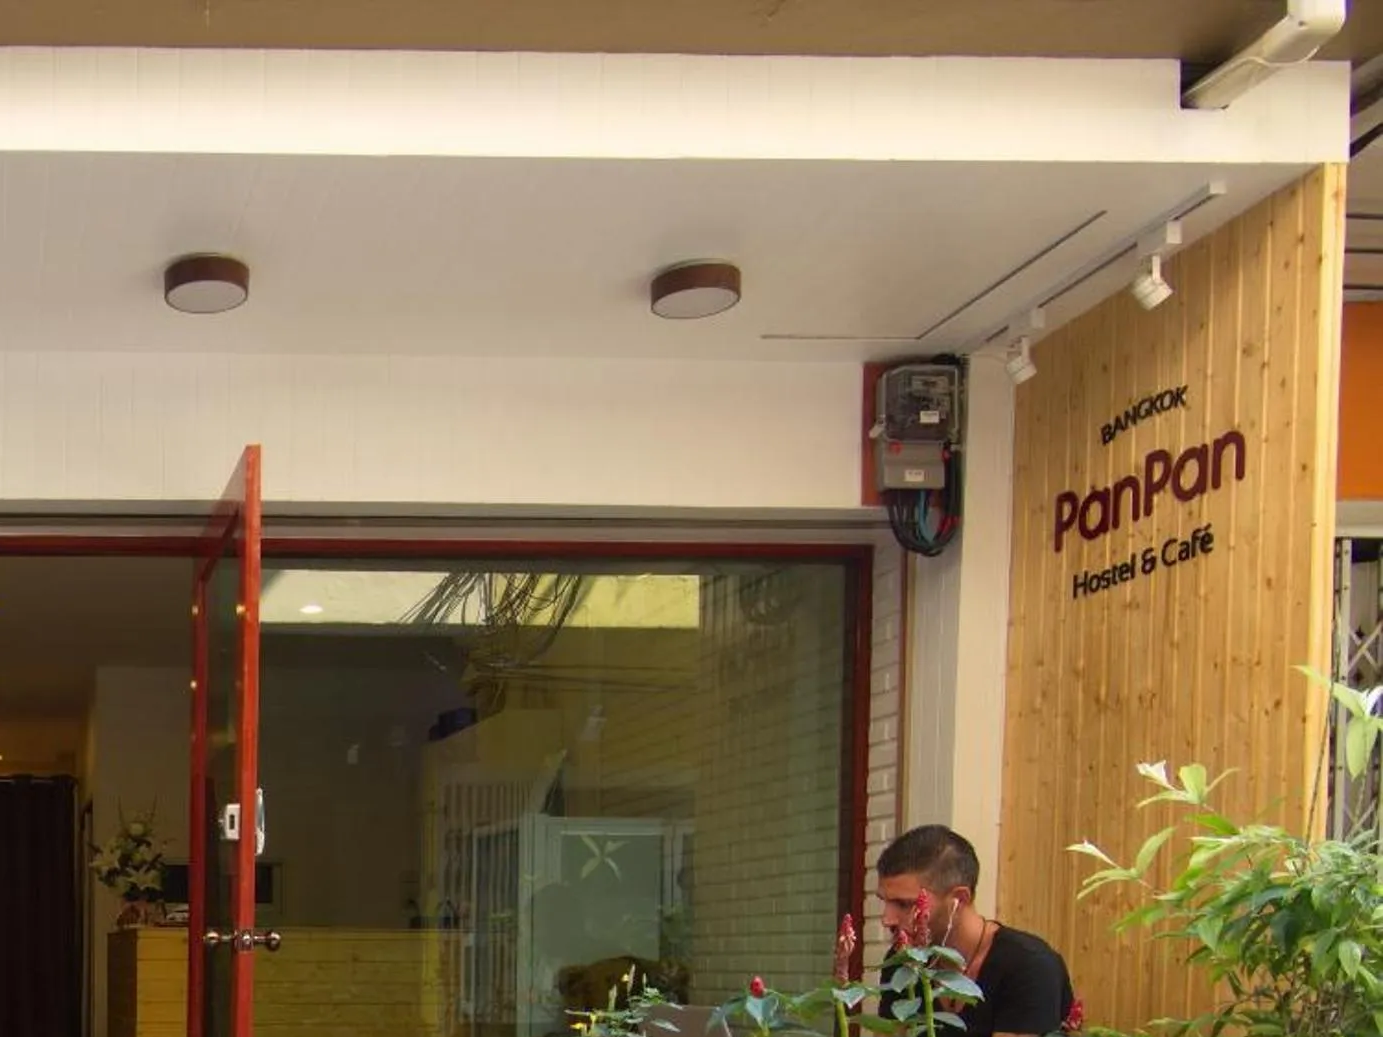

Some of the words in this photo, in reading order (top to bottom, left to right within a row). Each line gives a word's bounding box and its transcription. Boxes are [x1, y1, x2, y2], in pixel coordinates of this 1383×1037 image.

[1100, 384, 1188, 446] BANGKOK
[1053, 430, 1246, 553] PanPan
[1072, 553, 1136, 599] Hostel
[1140, 546, 1157, 575] &
[1161, 522, 1215, 567] Café
